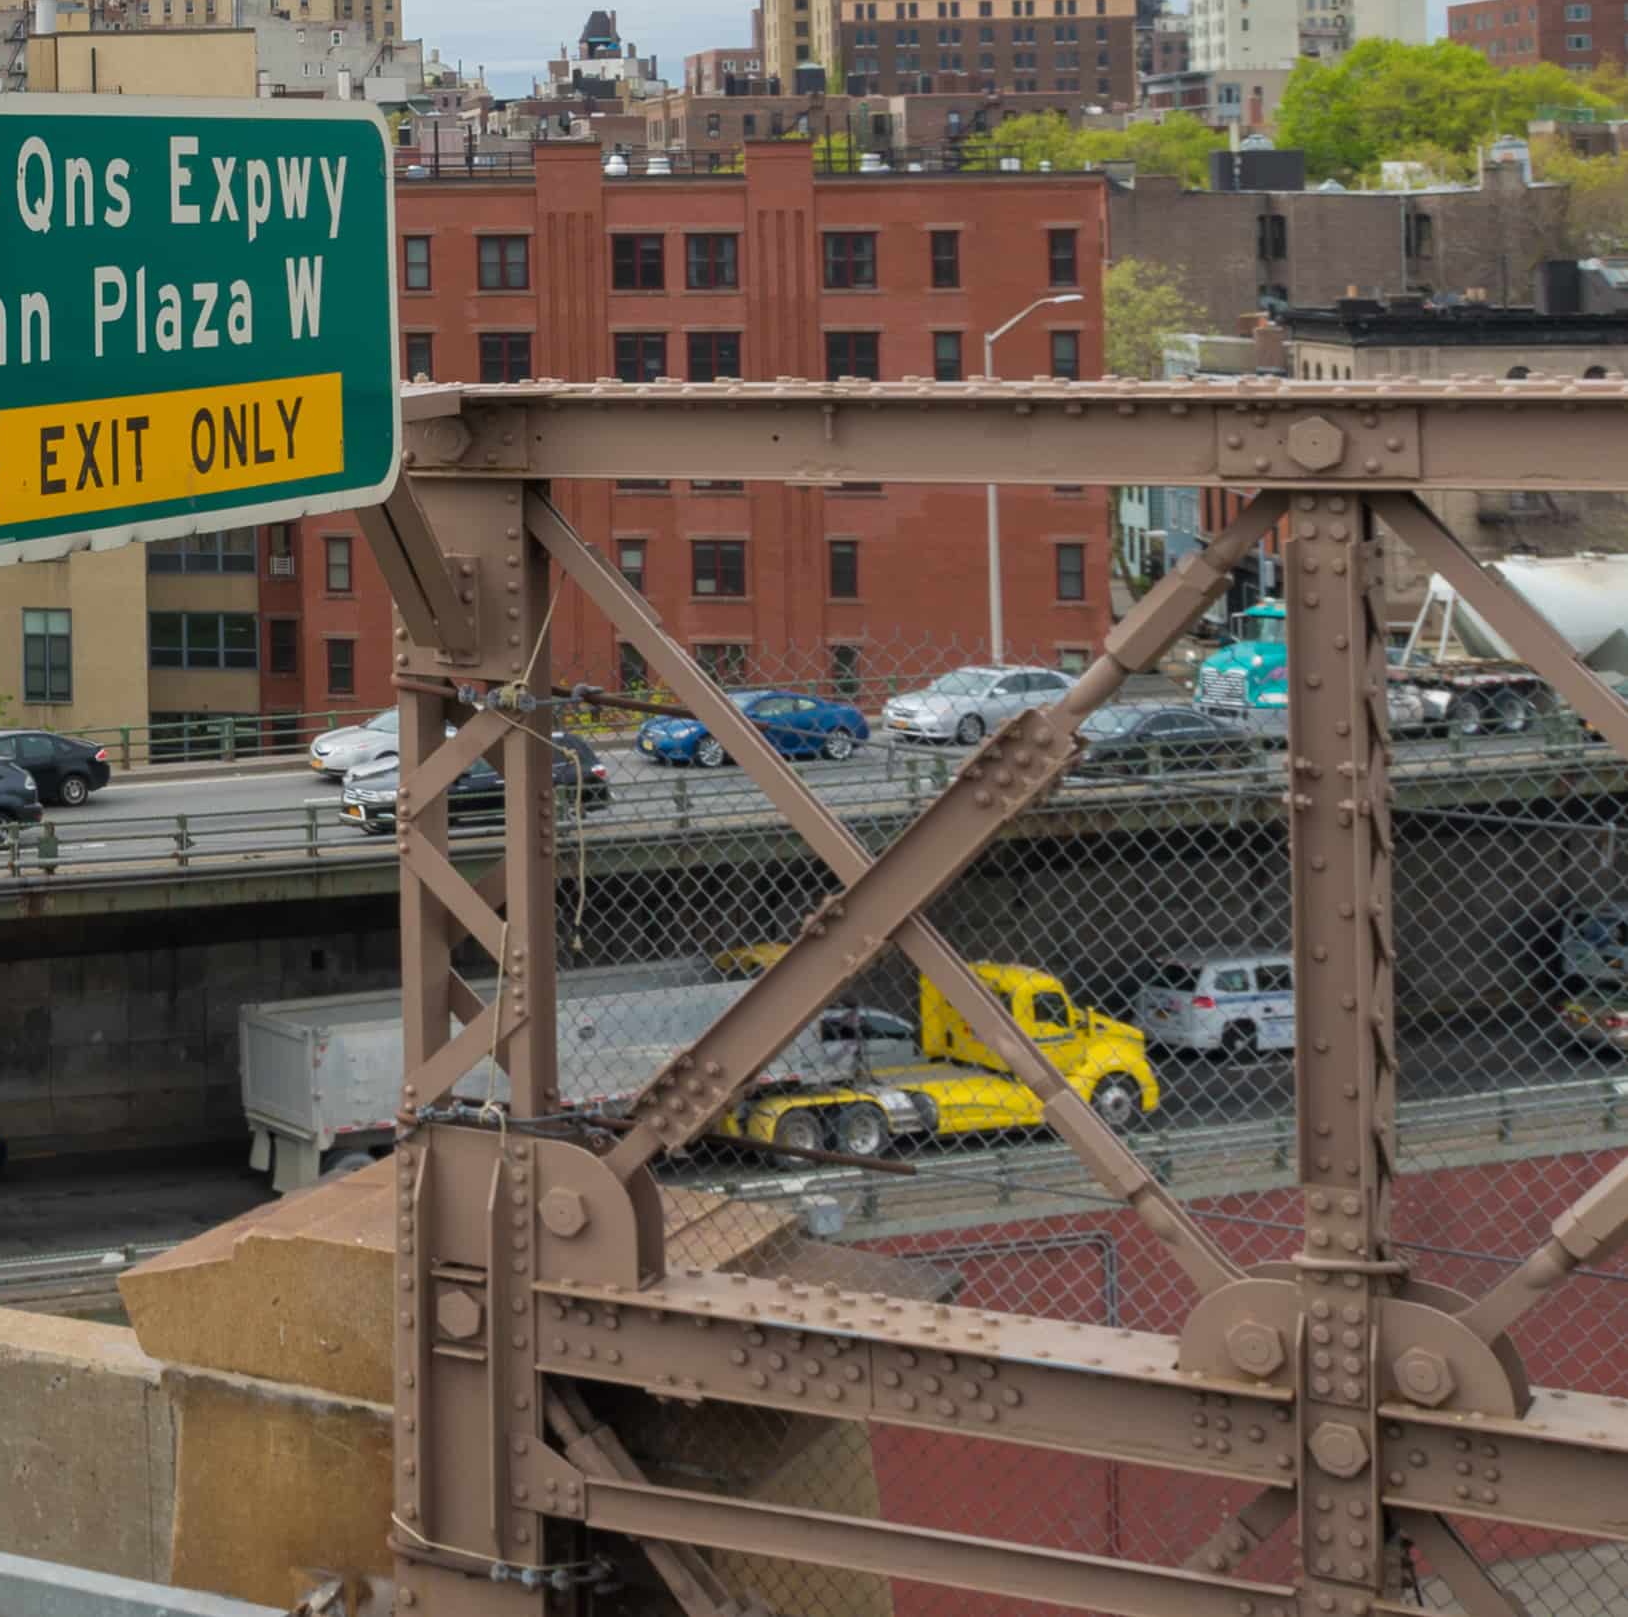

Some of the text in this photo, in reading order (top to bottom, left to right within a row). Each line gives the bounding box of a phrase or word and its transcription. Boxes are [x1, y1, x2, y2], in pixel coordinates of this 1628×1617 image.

[169, 135, 348, 243] Expwy
[93, 265, 253, 358] Plaza
[285, 255, 324, 340] W
[39, 415, 150, 495] EXIT
[190, 396, 303, 475] ONLY
